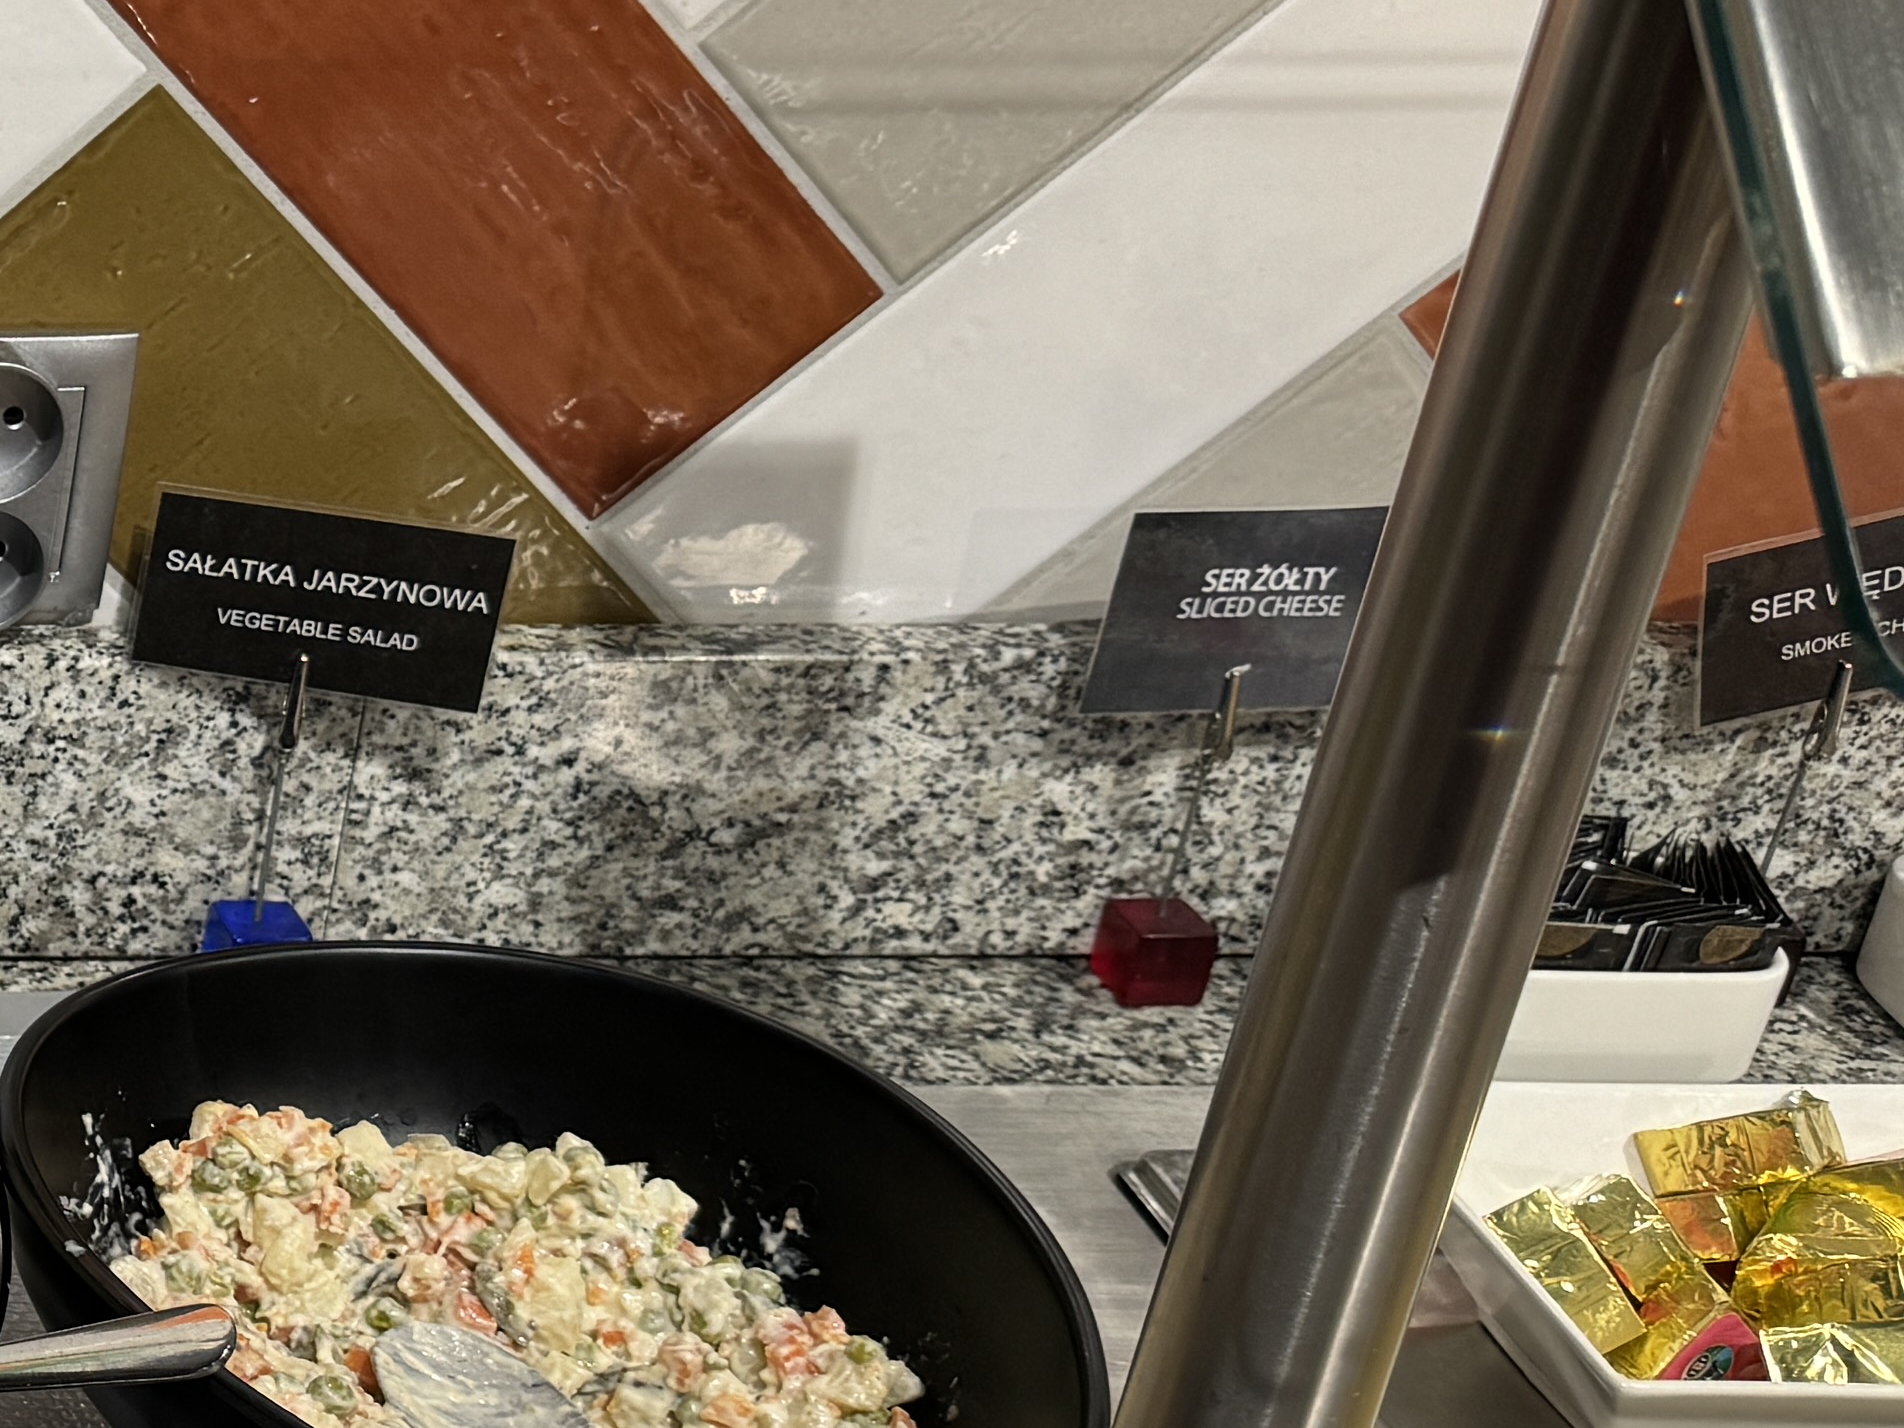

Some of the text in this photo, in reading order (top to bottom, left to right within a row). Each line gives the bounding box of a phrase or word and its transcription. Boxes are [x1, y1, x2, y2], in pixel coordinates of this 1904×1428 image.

[166, 549, 488, 614] SAŁATKA JARZYNOWA
[1202, 563, 1338, 593] SER ŻÓŁTY
[1176, 595, 1346, 620] SLICED CHEESE
[1749, 587, 1817, 624] SER
[217, 608, 418, 651] VEGETABLE SALAD
[1780, 631, 1854, 661] SMOKE
